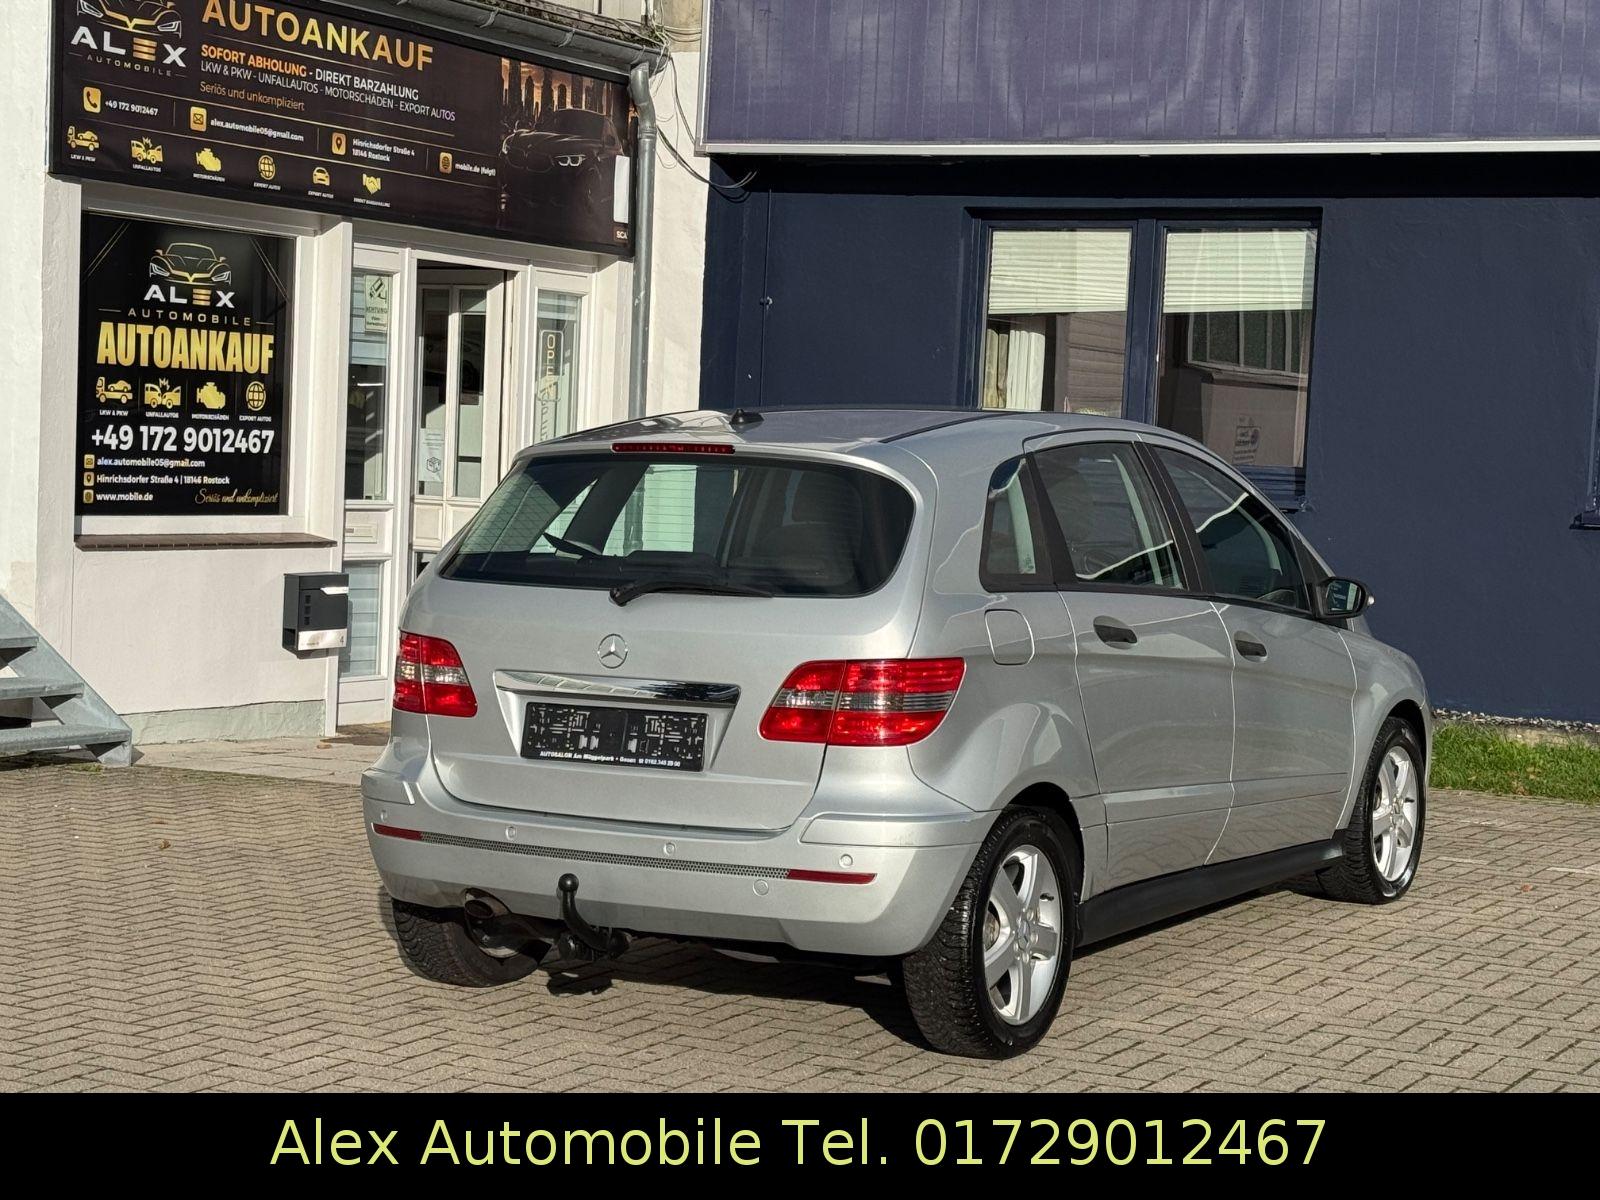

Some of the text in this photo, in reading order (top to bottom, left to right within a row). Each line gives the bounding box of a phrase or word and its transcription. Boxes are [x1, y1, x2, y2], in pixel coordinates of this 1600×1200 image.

[70, 25, 187, 68] ALEX
[202, 0, 433, 71] AUTOANKAUF
[86, 54, 172, 77] AUTOMOBILE
[201, 44, 246, 64] SOFORT
[247, 54, 307, 77] ABHOLUNG
[315, 68, 351, 87] DIREKT
[353, 76, 419, 101] BARZAHLUNG
[200, 61, 221, 74] LKW
[222, 65, 229, 76] &
[230, 66, 252, 80] PKW
[258, 72, 319, 94] UNFALLAUTOS
[325, 85, 394, 110] MOTORSCHÄDEN
[400, 100, 430, 117] EXPORT
[431, 109, 456, 122] AUTOS
[200, 81, 305, 111] Seriös und unkompliziert
[105, 100, 159, 116] +49 172 9012467
[210, 118, 304, 142] alex.automobile05@gmail.com
[368, 151, 391, 162] Rostock
[143, 284, 235, 309] ALEX
[127, 307, 251, 326] AUTOMOBILE
[96, 321, 275, 375] AUTOANKAUF
[91, 424, 275, 454] +49 172 9012467
[96, 456, 206, 469] alex.automobile05@gmail.com
[96, 474, 149, 484] Hinrichsdorfer
[150, 475, 173, 484] Straße
[173, 476, 179, 484] 4
[183, 475, 202, 485] 18146
[202, 476, 231, 485] Rostock
[96, 492, 154, 501] www.mobile.de
